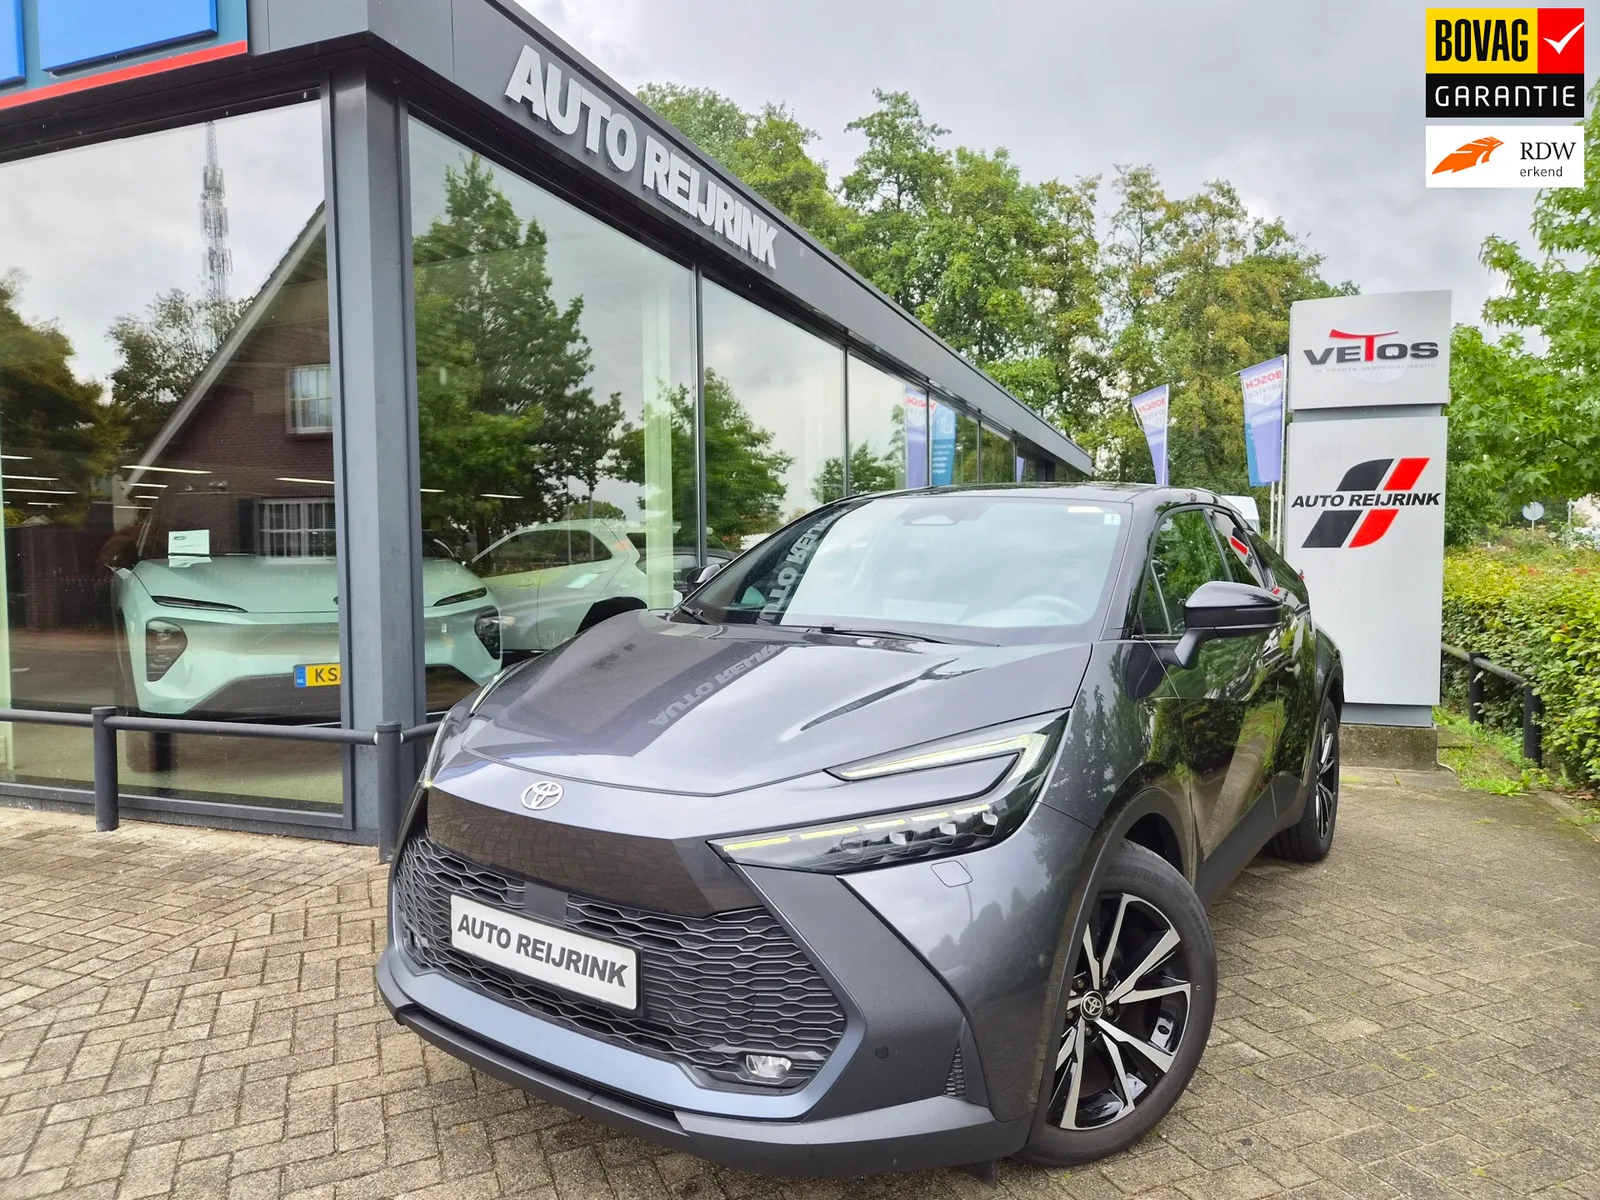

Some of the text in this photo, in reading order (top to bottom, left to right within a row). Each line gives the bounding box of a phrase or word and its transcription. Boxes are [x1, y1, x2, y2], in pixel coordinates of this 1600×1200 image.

[505, 45, 778, 270] AUTO REIJRINK
[1303, 329, 1439, 365] VETOS
[1291, 492, 1442, 508] AUTO REIJRINK
[457, 913, 628, 988] AUTO REIJRINK
